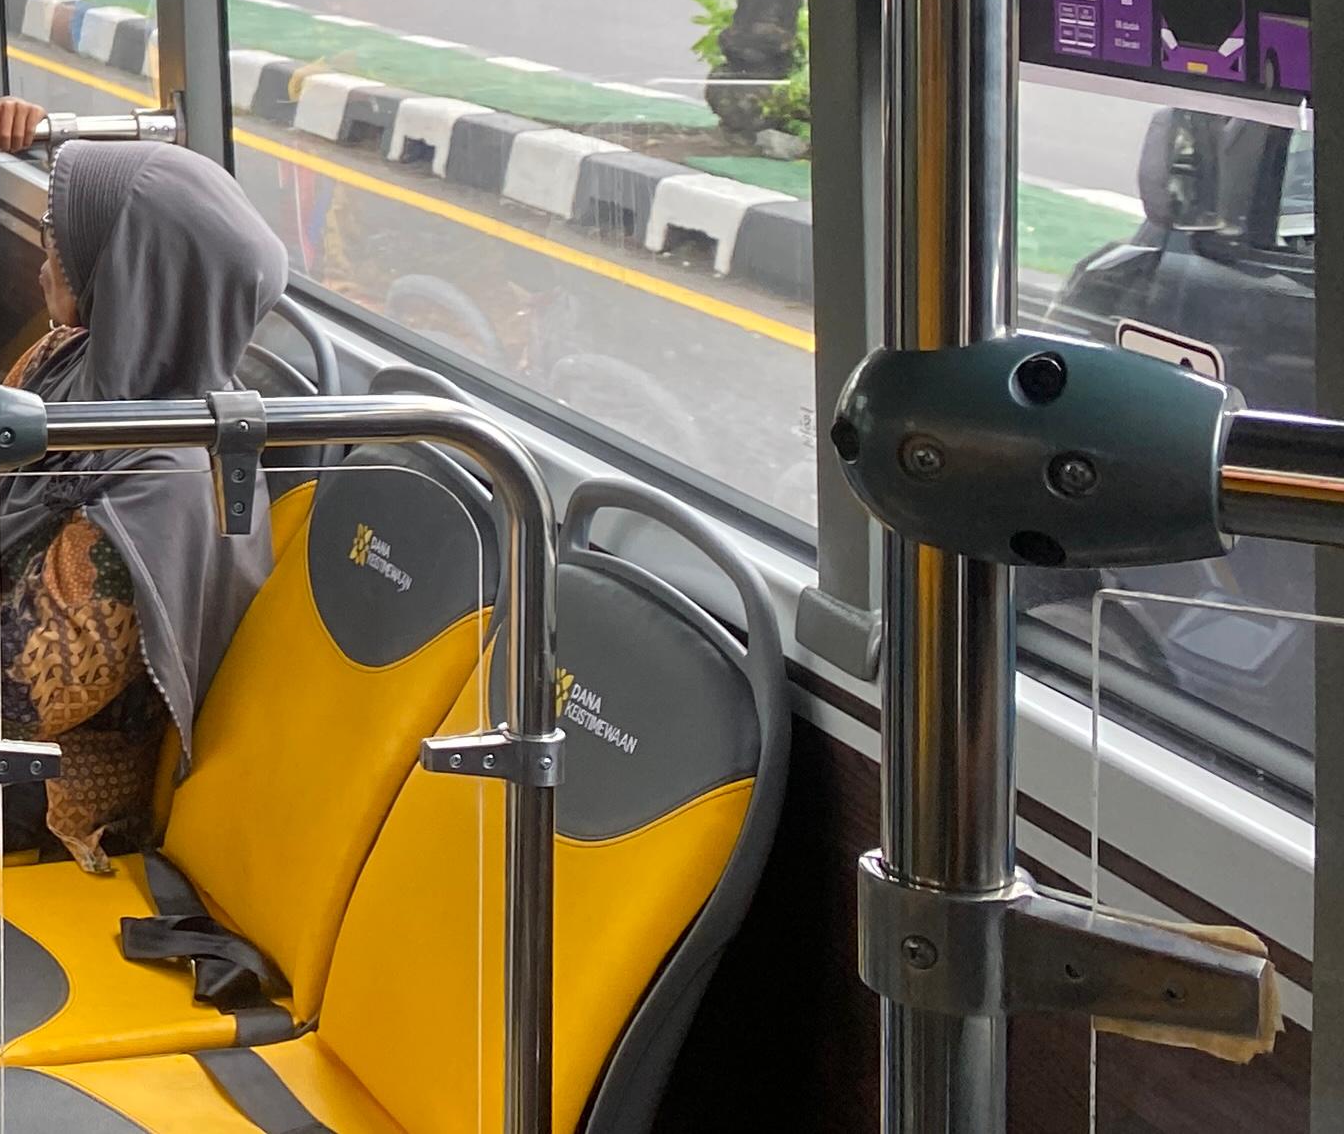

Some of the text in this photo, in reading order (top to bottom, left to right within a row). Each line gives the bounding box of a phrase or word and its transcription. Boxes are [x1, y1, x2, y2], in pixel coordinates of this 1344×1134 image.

[371, 536, 391, 559] DANA
[571, 683, 602, 714] DANA
[564, 700, 638, 755] KEISTIMEWAAN
